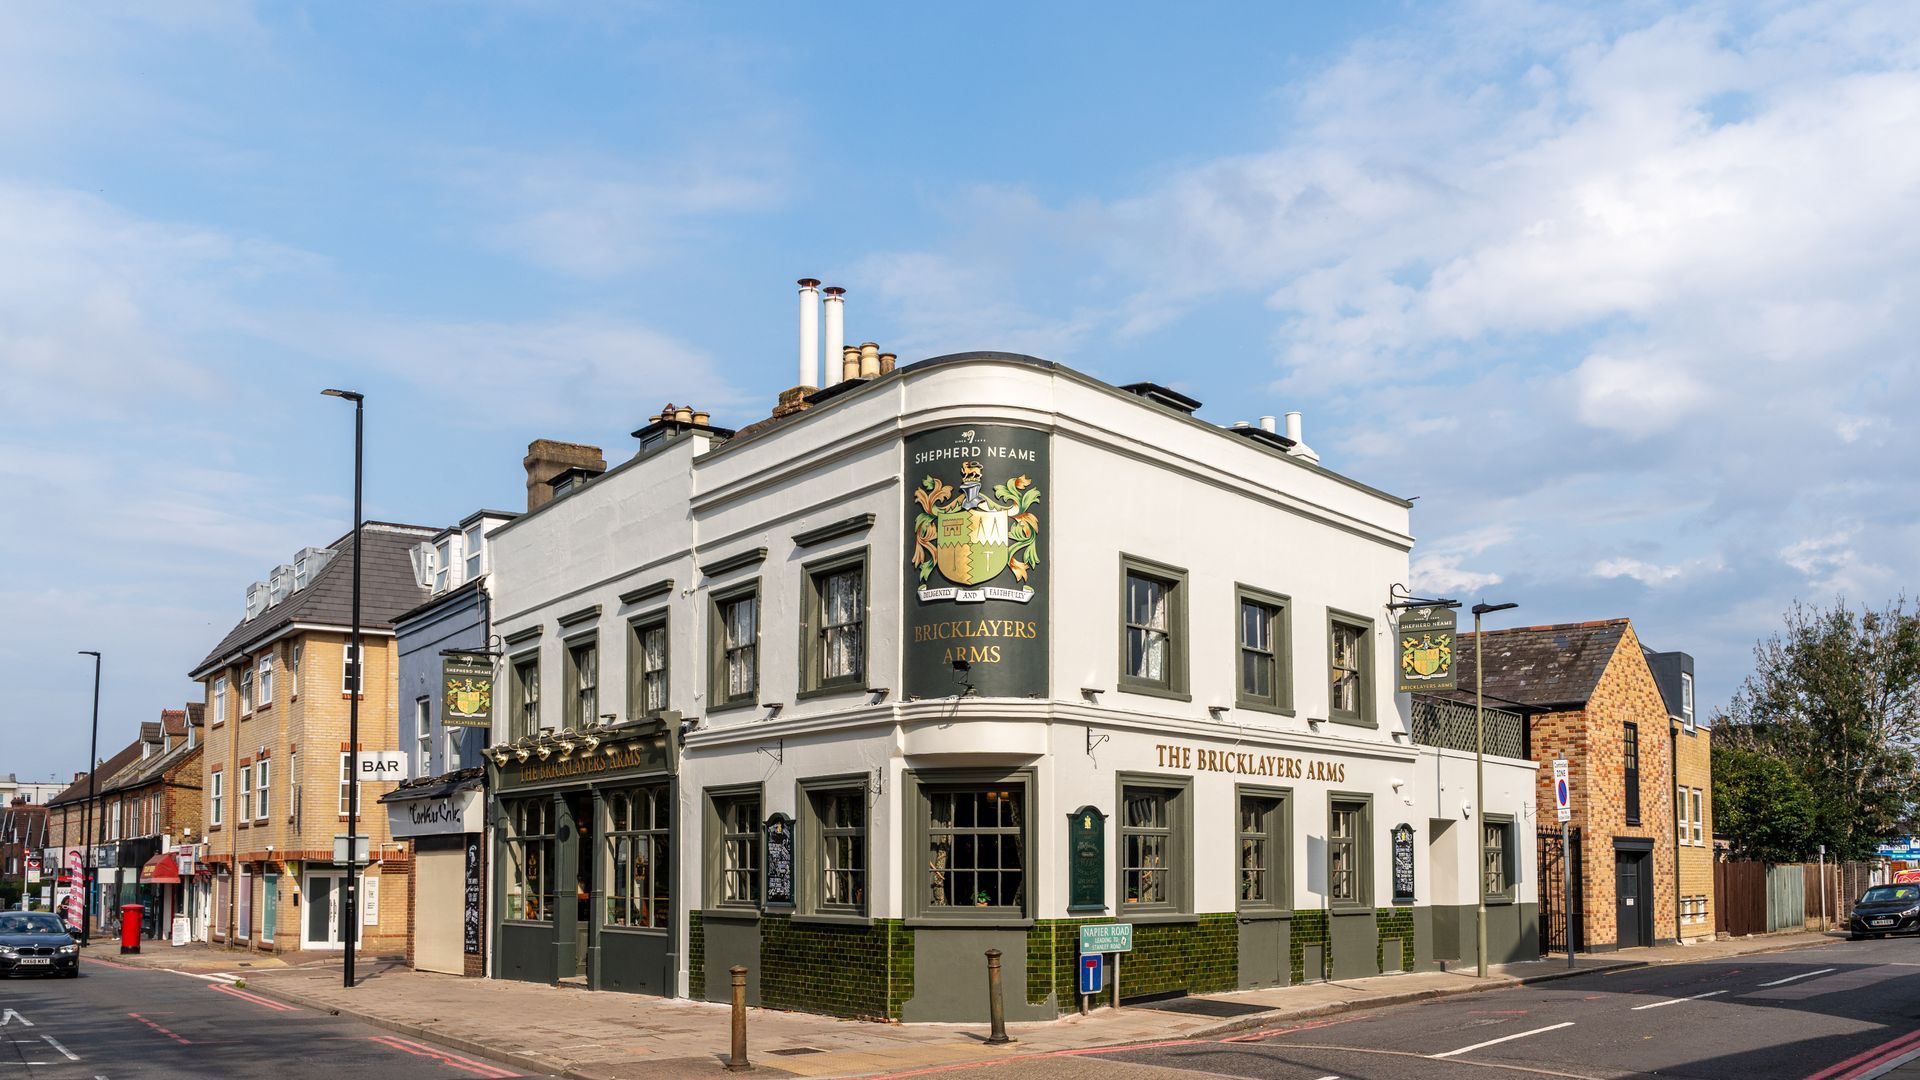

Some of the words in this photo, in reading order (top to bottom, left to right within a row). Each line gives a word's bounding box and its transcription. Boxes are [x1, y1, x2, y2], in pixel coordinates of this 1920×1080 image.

[915, 446, 981, 464] SHEPHERD
[987, 446, 1036, 462] NEAME
[962, 591, 977, 600] AND
[913, 619, 1037, 642] BRICKLAYERS
[942, 645, 1001, 665] ARMS
[1400, 683, 1436, 691] BRICKLAYERS
[362, 760, 399, 772] BAR
[520, 766, 538, 781] THE
[540, 753, 606, 779] BRICKLAYERS
[609, 747, 642, 770] ARMS
[1155, 743, 1191, 770] THE
[1197, 748, 1302, 780] BRICKLAYERS
[1306, 759, 1345, 784] ARMS
[1083, 927, 1109, 938] NAPIER
[1111, 926, 1130, 936] ROAD
[1094, 936, 1112, 944] LEADING
